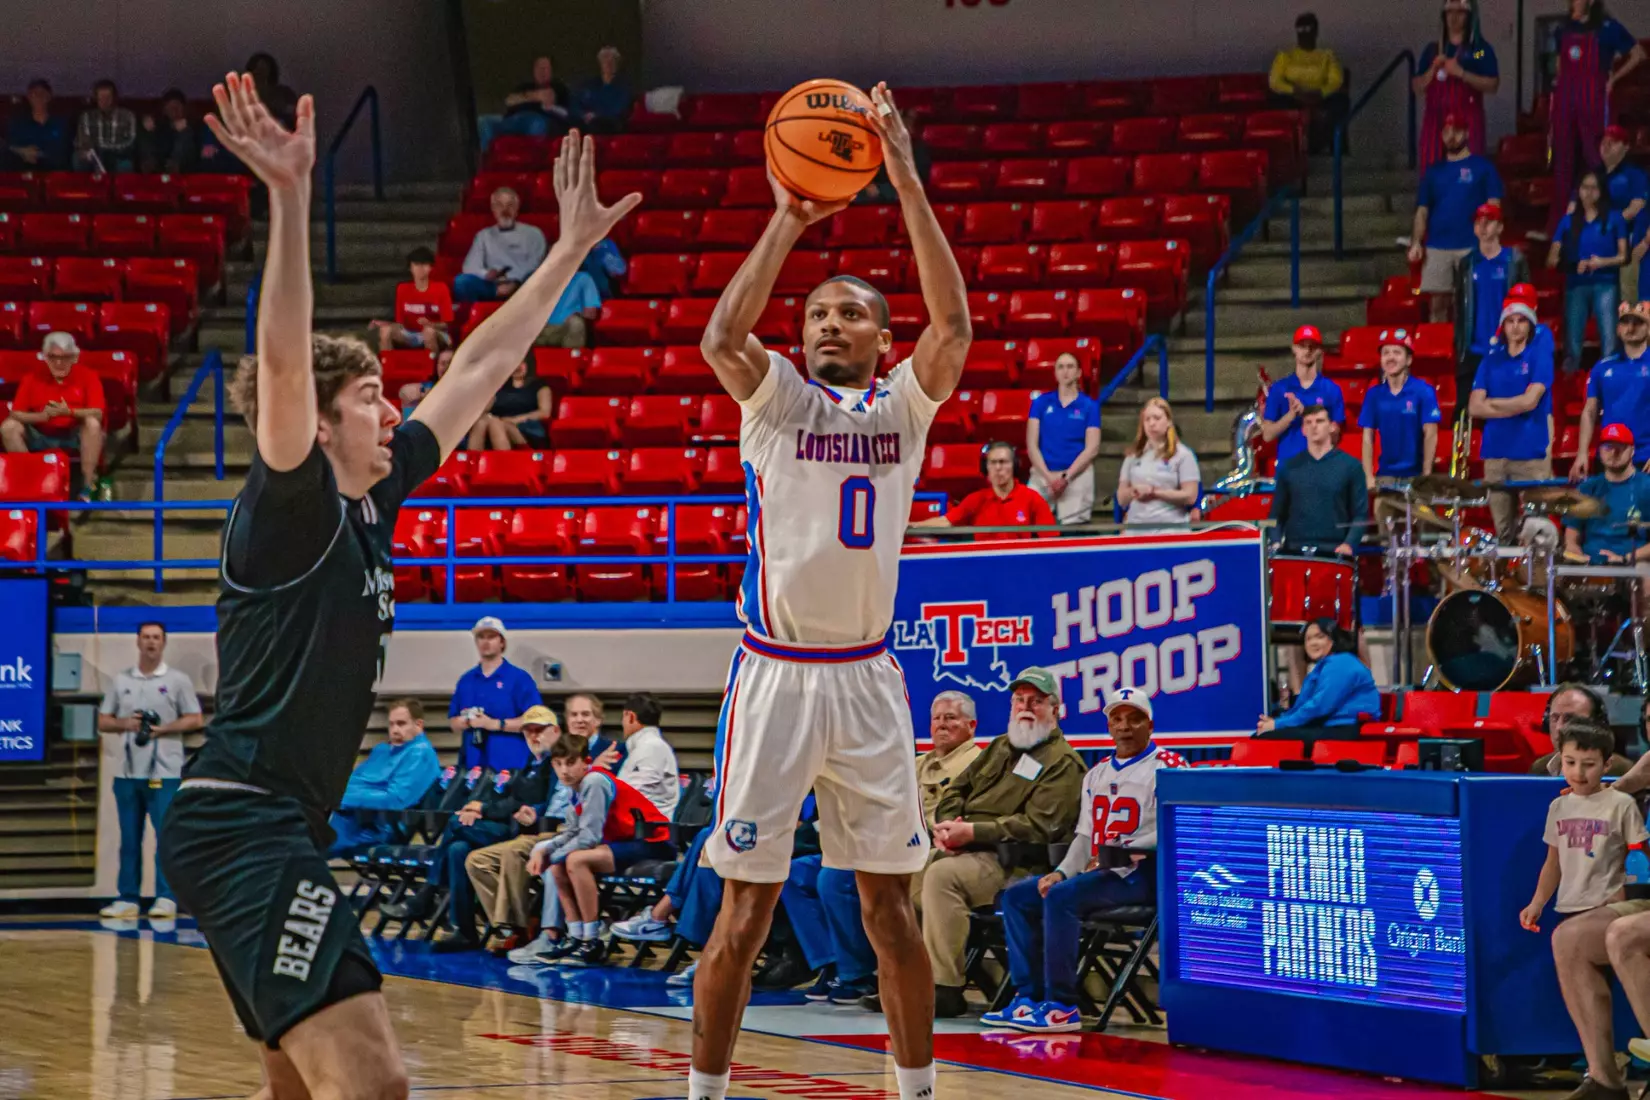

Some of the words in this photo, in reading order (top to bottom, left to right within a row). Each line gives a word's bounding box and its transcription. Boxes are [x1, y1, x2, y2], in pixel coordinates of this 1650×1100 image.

[838, 475, 876, 550] 0
[893, 620, 939, 650] LA
[1052, 558, 1217, 650] HOOP
[0, 656, 33, 682] nk
[1040, 624, 1241, 719] TROOP
[1119, 689, 1134, 700] T
[1091, 795, 1141, 856] 82
[1266, 824, 1367, 905] PREMIER
[273, 879, 336, 982] BEARS
[1261, 901, 1378, 987] PARTNERS
[1387, 922, 1431, 957] Origin
